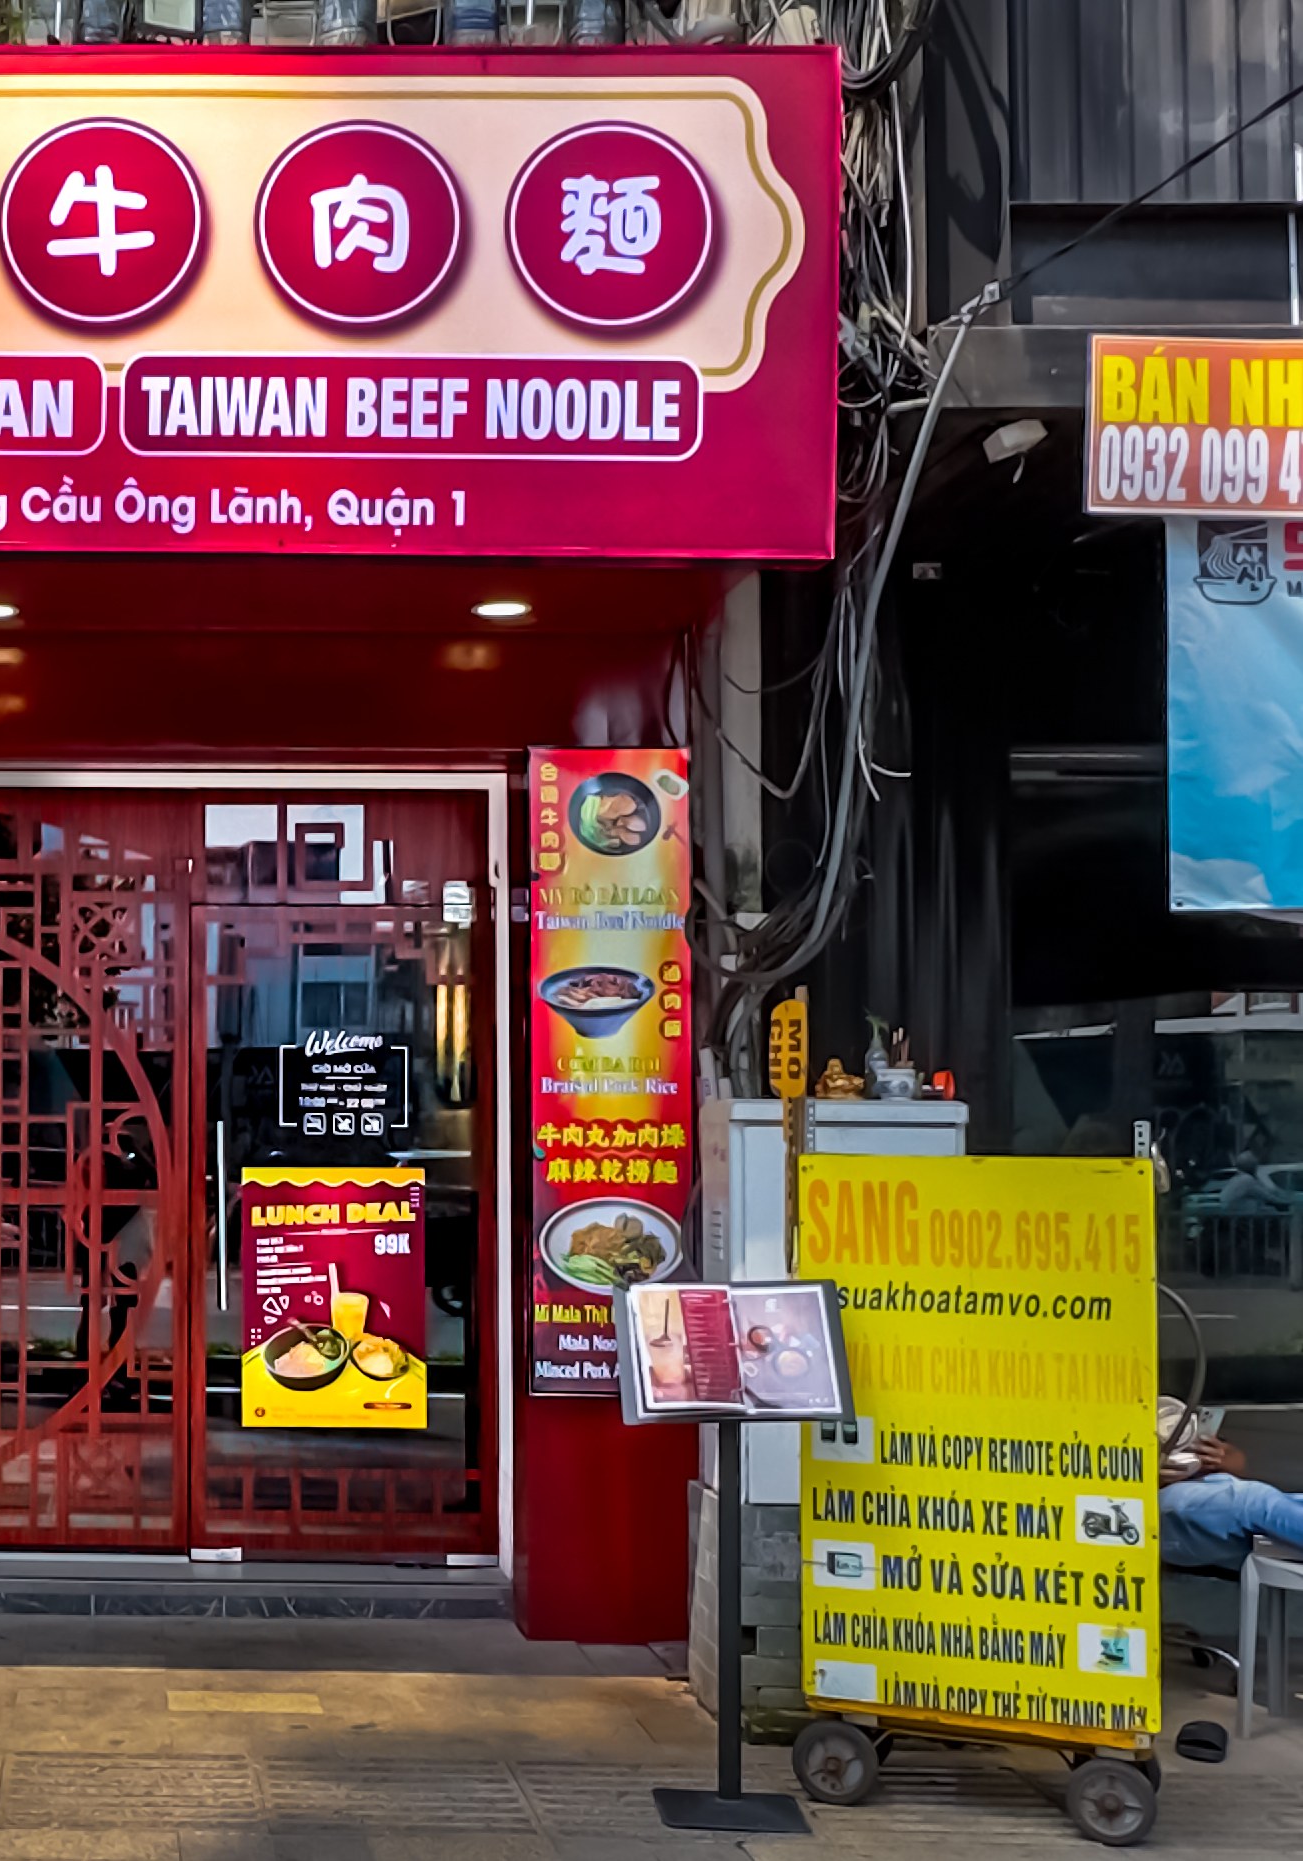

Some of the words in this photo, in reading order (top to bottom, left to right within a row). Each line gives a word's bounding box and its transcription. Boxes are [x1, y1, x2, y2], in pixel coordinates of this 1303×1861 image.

[141, 376, 327, 437] TAIWAN
[347, 377, 469, 439] BEEF
[485, 378, 681, 441] NOODLE
[1102, 346, 1210, 425] BÁN
[1230, 358, 1303, 428] NH
[1098, 424, 1190, 501] 0932
[1200, 426, 1269, 504] 099
[1278, 430, 1303, 504] 4
[20, 475, 100, 525] Cầu
[114, 477, 196, 534] Ông
[209, 487, 314, 532] Lãnh,
[327, 487, 436, 536] Quận
[452, 490, 466, 526] 1
[304, 1030, 384, 1057] Welcome
[646, 1077, 678, 1095] Rice
[251, 1204, 340, 1228] LUNCH
[345, 1201, 416, 1225] DEAL
[374, 1233, 411, 1256] 99K
[807, 1179, 921, 1266] SANG
[928, 1208, 1141, 1275] 0902.695.415
[837, 1280, 1113, 1322] suakhoatamvo.com
[559, 1334, 590, 1351] Mala
[881, 1424, 913, 1467] LÀM
[918, 1425, 939, 1467] VÀ
[942, 1434, 984, 1471] COPY
[989, 1438, 1055, 1477] REMOTE
[1059, 1431, 1092, 1480] CỬA
[1097, 1433, 1144, 1483] CUỐN
[812, 1480, 855, 1524] LÀM
[862, 1485, 911, 1529] CHÌA
[917, 1490, 975, 1534] KHÓA
[982, 1499, 1008, 1536] XE
[1016, 1497, 1064, 1542] MÁY
[881, 1545, 922, 1592] MỞ
[930, 1548, 963, 1596] VÀ
[972, 1552, 1026, 1602] SỬA
[1034, 1562, 1084, 1606] KÉT
[1093, 1560, 1146, 1614] SẮT
[814, 1604, 846, 1646] LÀM
[851, 1606, 889, 1652] CHÌA
[892, 1611, 934, 1655] KHÓA
[940, 1616, 975, 1660] NHÀ
[979, 1613, 1024, 1664] BẰNG
[1030, 1625, 1066, 1670] MÁY
[884, 1671, 917, 1707] LÀM
[946, 1686, 987, 1716] COPY
[1051, 1696, 1105, 1726] THANG
